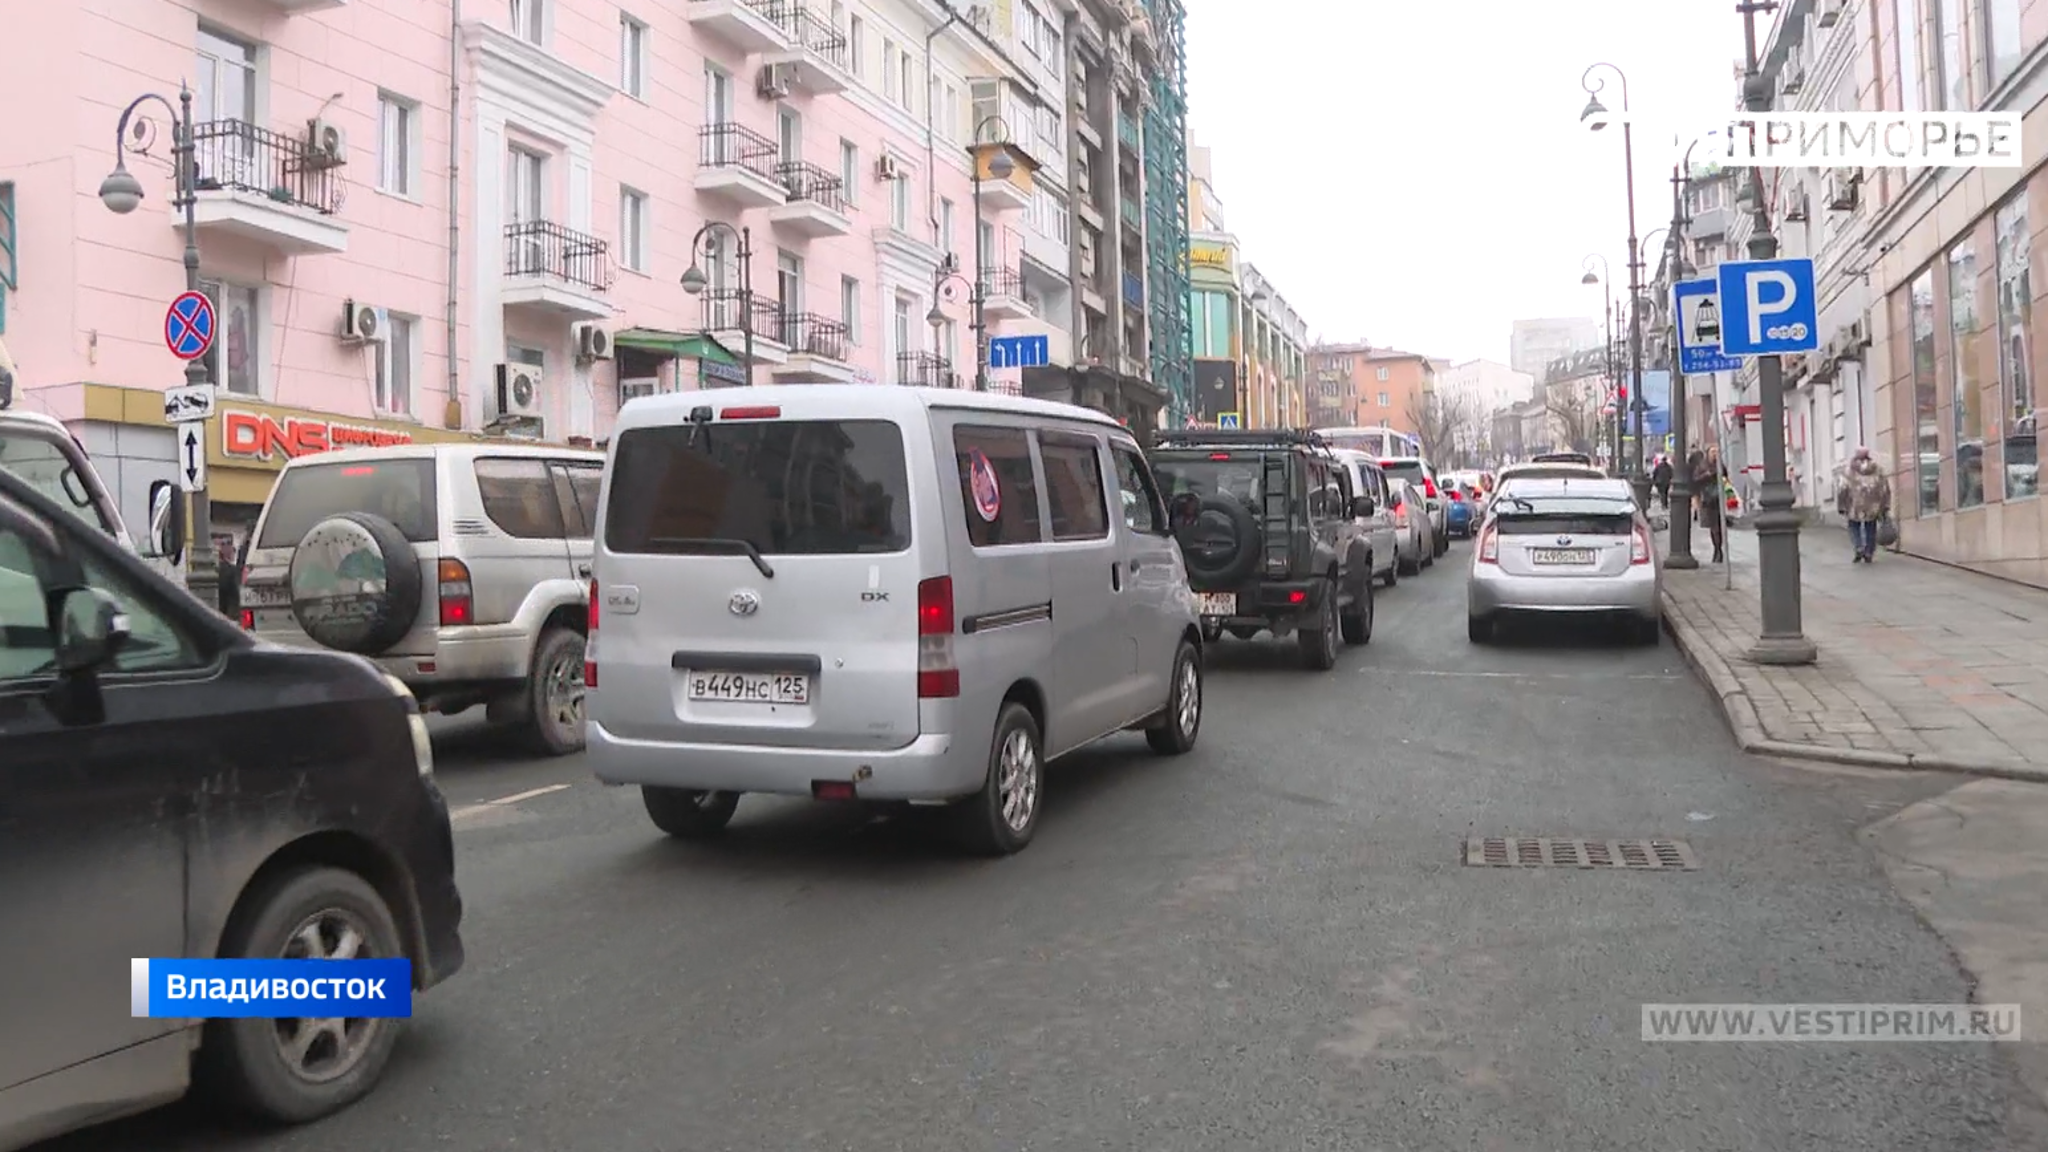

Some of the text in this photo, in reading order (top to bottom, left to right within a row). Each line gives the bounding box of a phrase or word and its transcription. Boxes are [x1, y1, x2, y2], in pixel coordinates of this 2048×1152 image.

[225, 411, 330, 458] DNS
[861, 592, 890, 602] DX
[695, 674, 804, 698] В449НС 125
